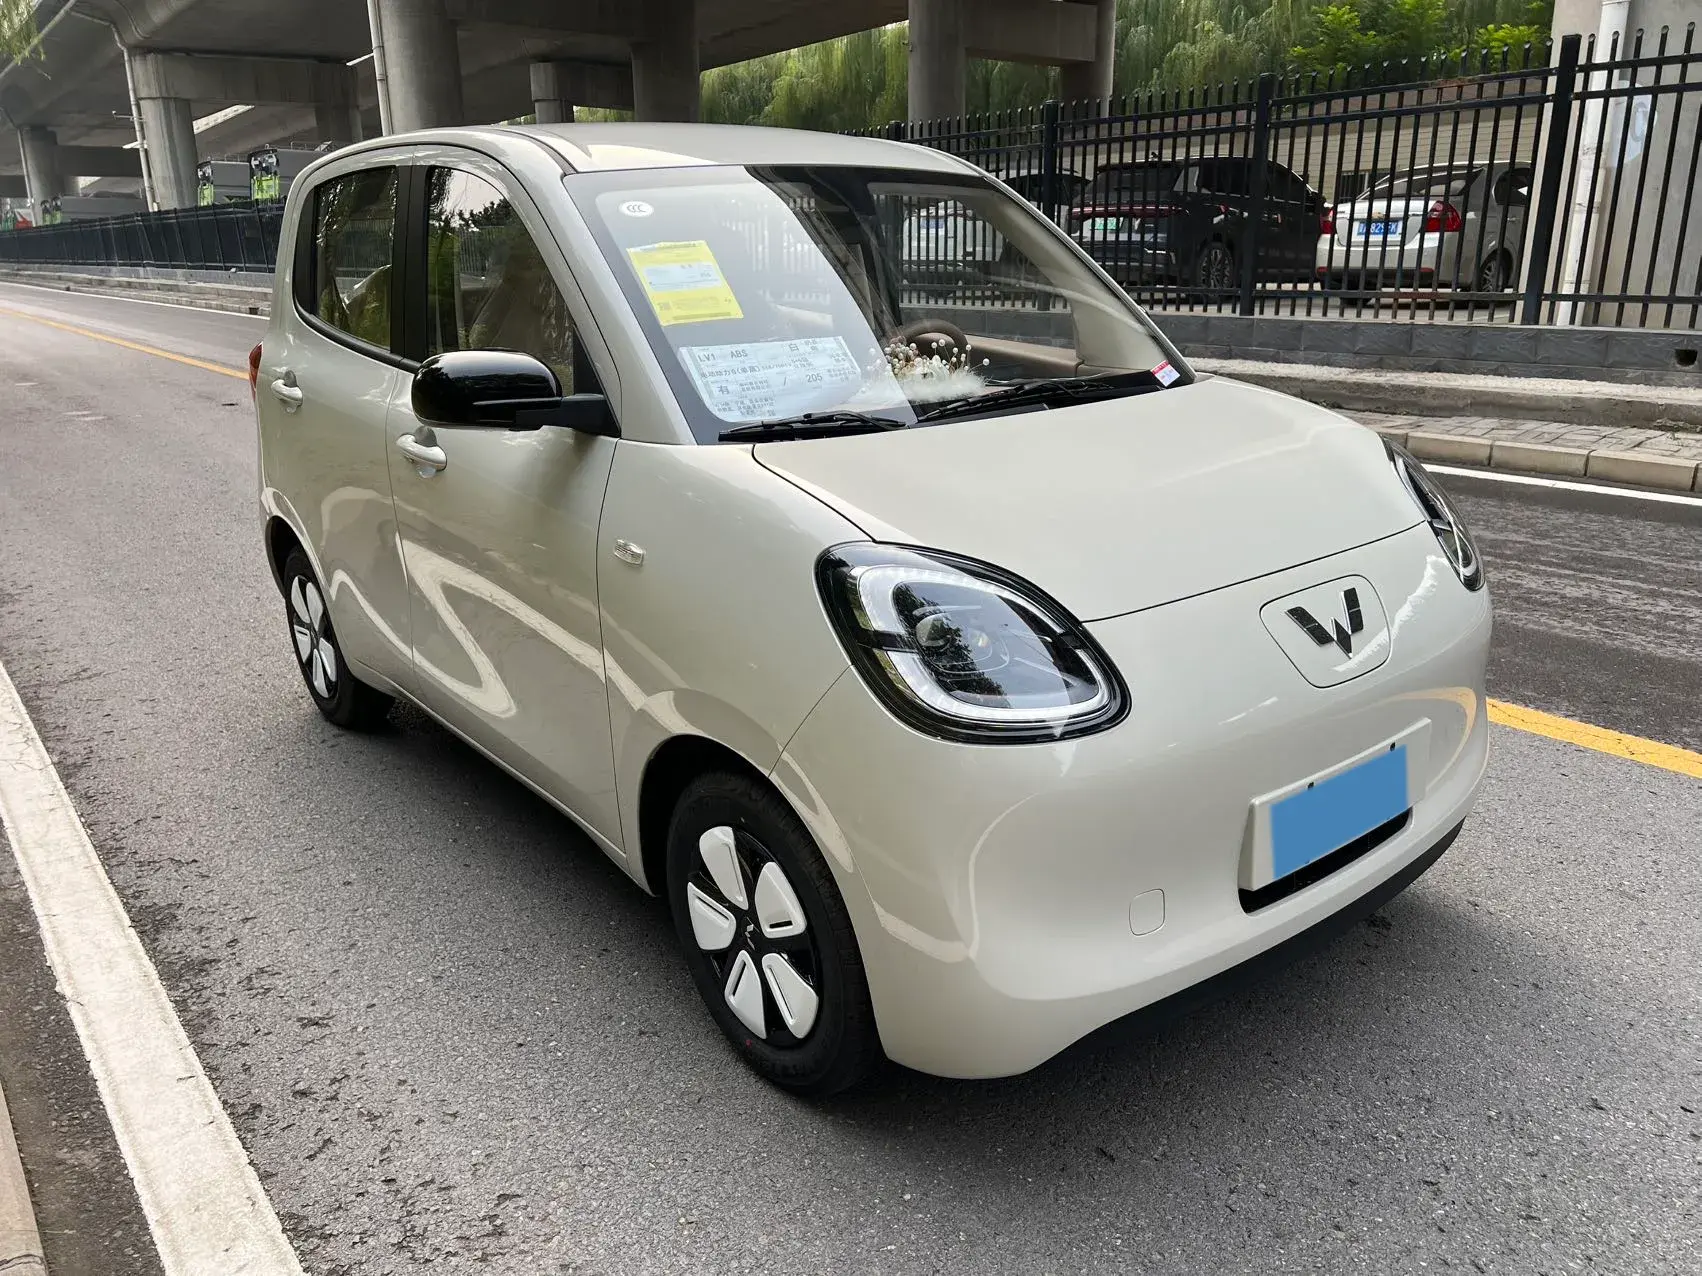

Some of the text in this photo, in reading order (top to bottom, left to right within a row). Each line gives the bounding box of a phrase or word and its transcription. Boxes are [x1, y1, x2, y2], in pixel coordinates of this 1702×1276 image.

[730, 349, 748, 359] ABS
[789, 343, 800, 352] 白
[716, 384, 730, 395] 有
[805, 372, 823, 383] 205
